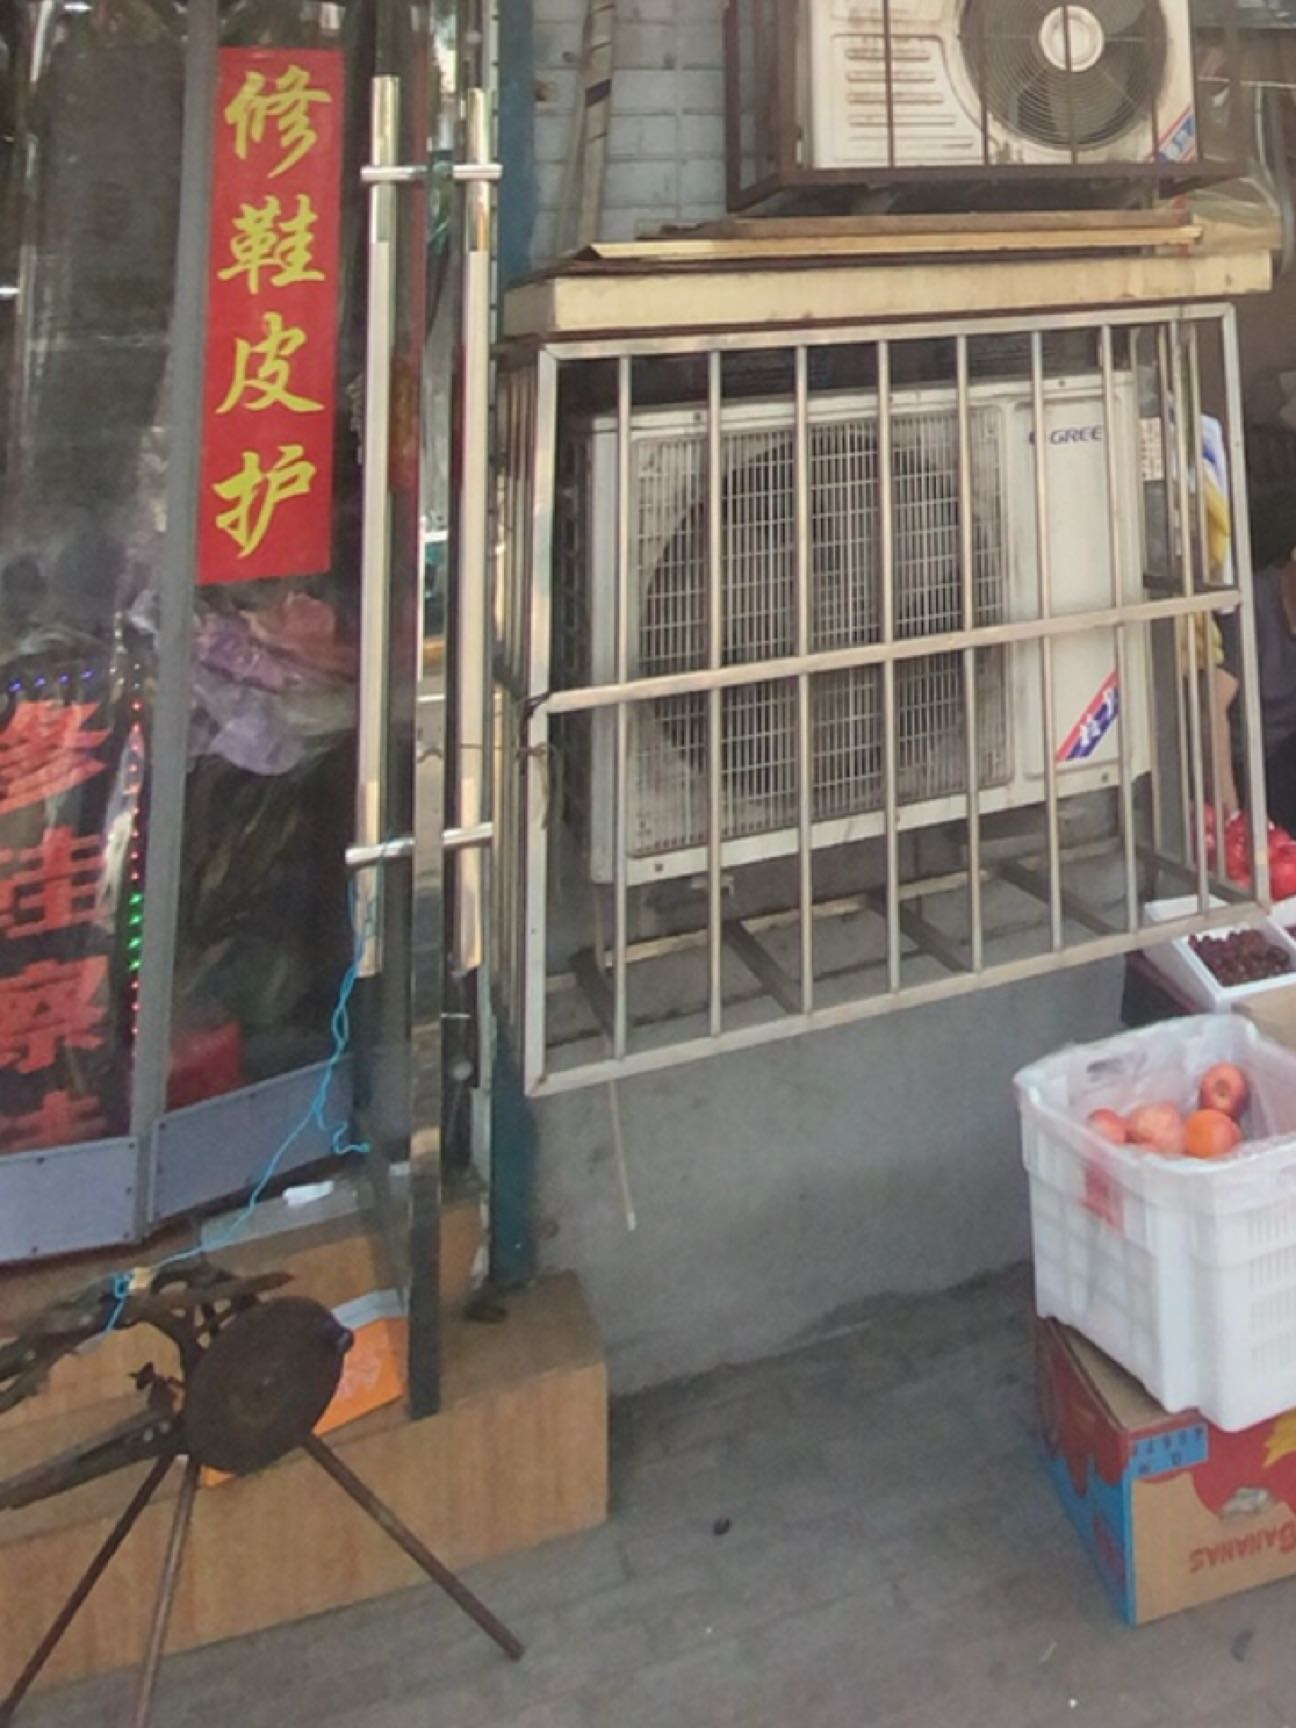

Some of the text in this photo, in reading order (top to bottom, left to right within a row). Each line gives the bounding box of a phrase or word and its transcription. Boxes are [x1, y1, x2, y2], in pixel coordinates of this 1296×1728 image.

[213, 65, 332, 559] 修鞋皮护
[1050, 425, 1104, 445] GREE
